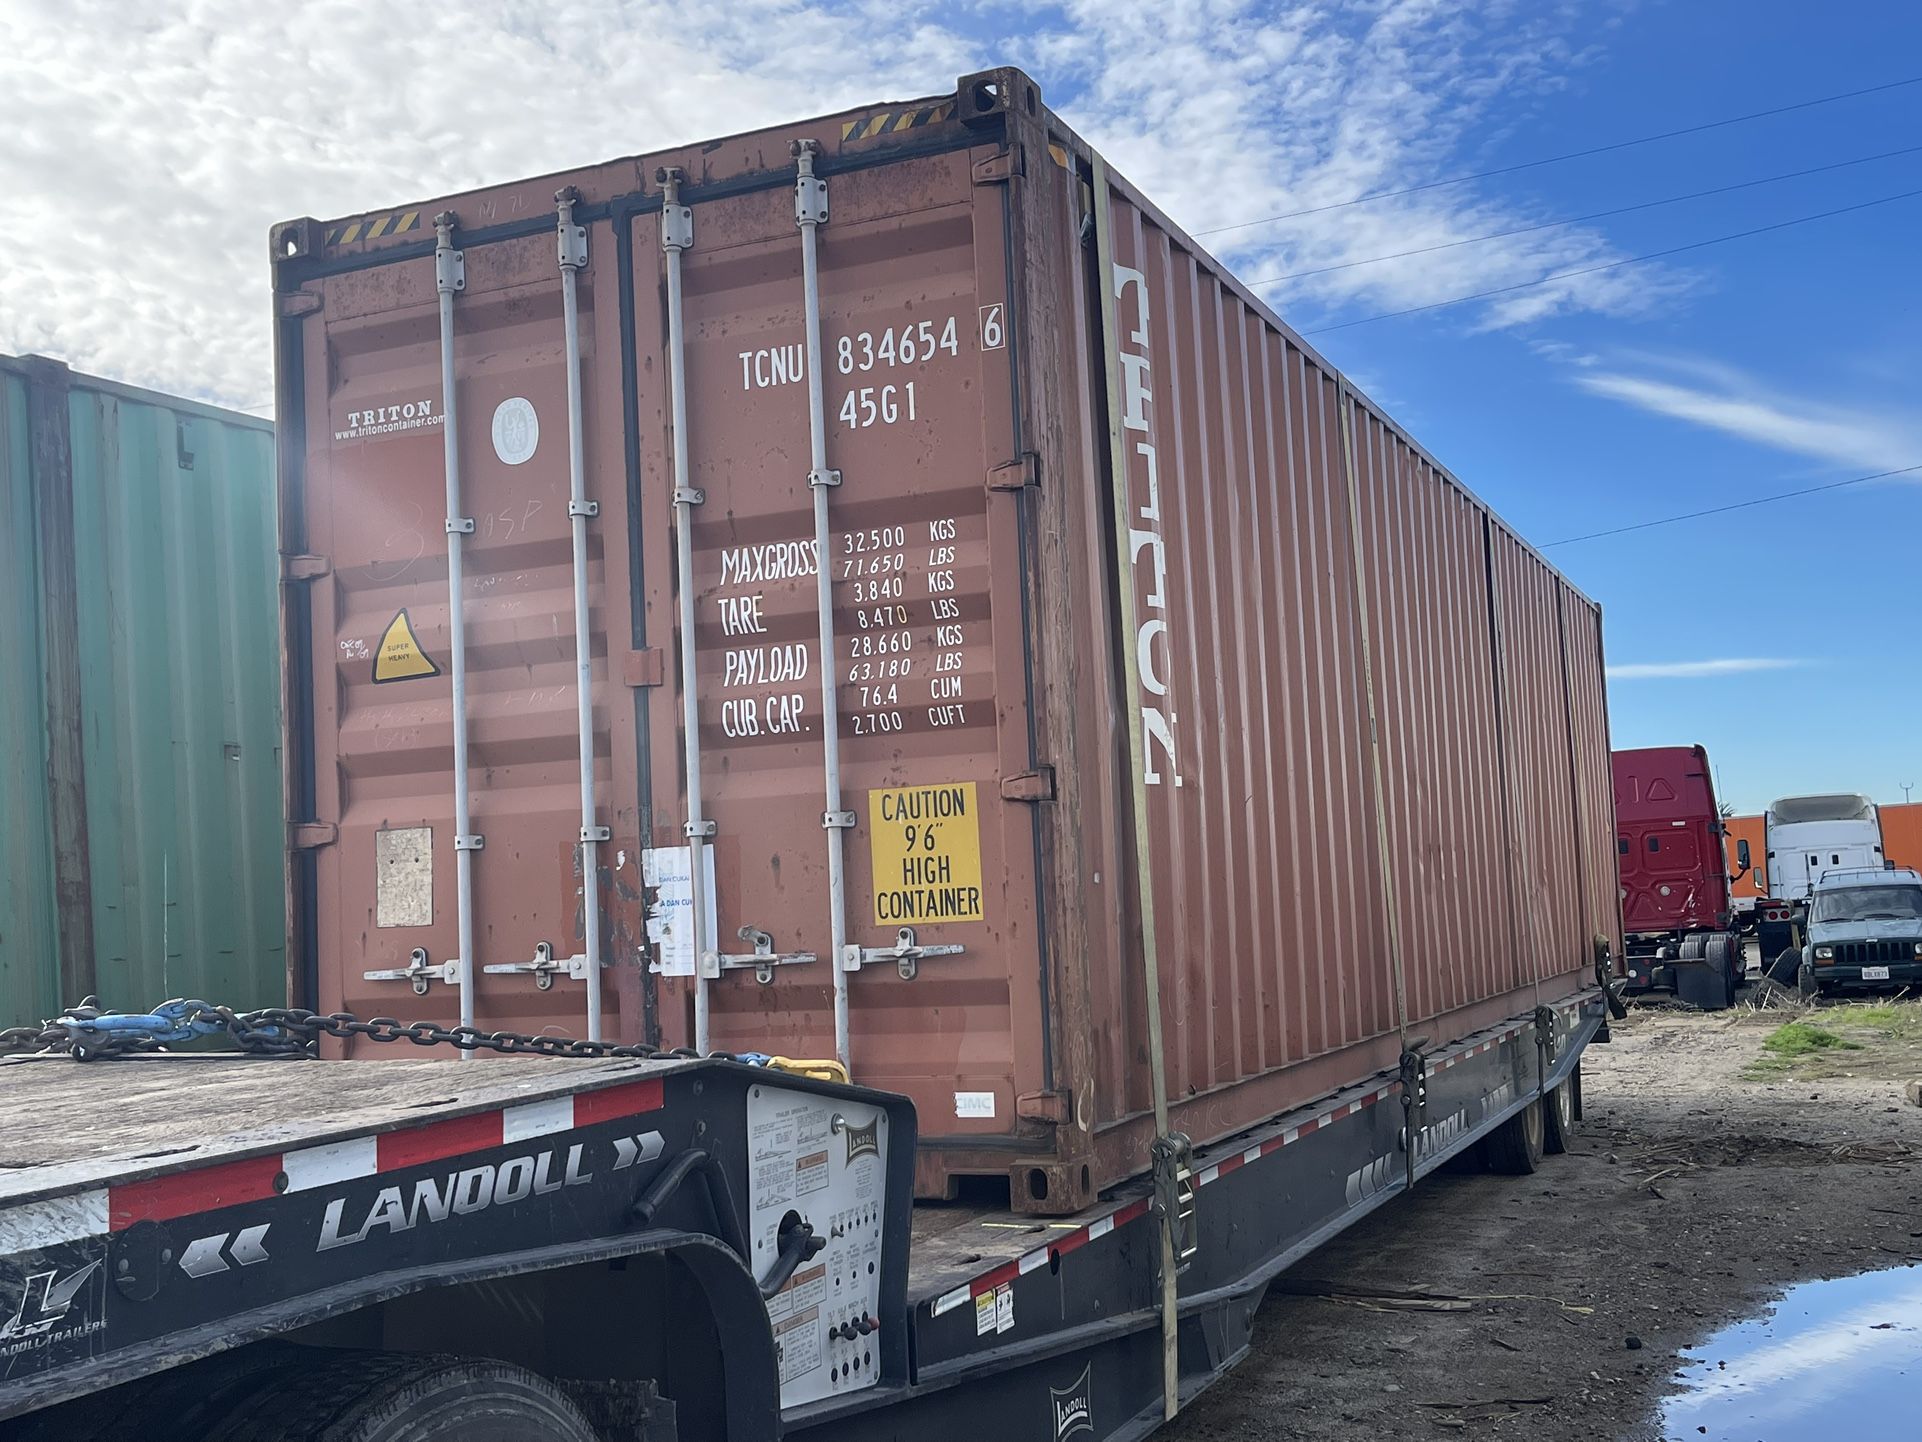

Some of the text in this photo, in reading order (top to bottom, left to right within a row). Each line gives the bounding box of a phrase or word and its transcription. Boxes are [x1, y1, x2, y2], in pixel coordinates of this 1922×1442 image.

[739, 306, 1002, 391] TCNU 834654 6
[348, 400, 432, 428] TRITON
[839, 381, 916, 430] 45G1
[335, 414, 446, 440] www.tritoncontainer.com
[719, 539, 819, 586] MAXGROSS
[929, 519, 956, 542] KGS
[928, 546, 955, 566] LBS
[718, 595, 767, 636] TARE
[928, 570, 955, 593] KGS
[931, 598, 960, 620] LBS
[387, 643, 409, 652] SUPER
[388, 653, 410, 662] HEAVY
[723, 643, 809, 687] PAYLOAD
[936, 624, 964, 648] KGS
[935, 652, 963, 673] LBS
[860, 683, 898, 708] 76.4
[930, 676, 962, 699] CUM
[928, 704, 966, 727] CUFT
[881, 788, 965, 821] CAUTION
[902, 855, 950, 885] HIGH
[877, 886, 980, 920] CONTAINER
[848, 1132, 876, 1157] LANDOLL
[316, 1143, 593, 1252] LANDOLL
[1056, 1397, 1088, 1437] LANDOLL
